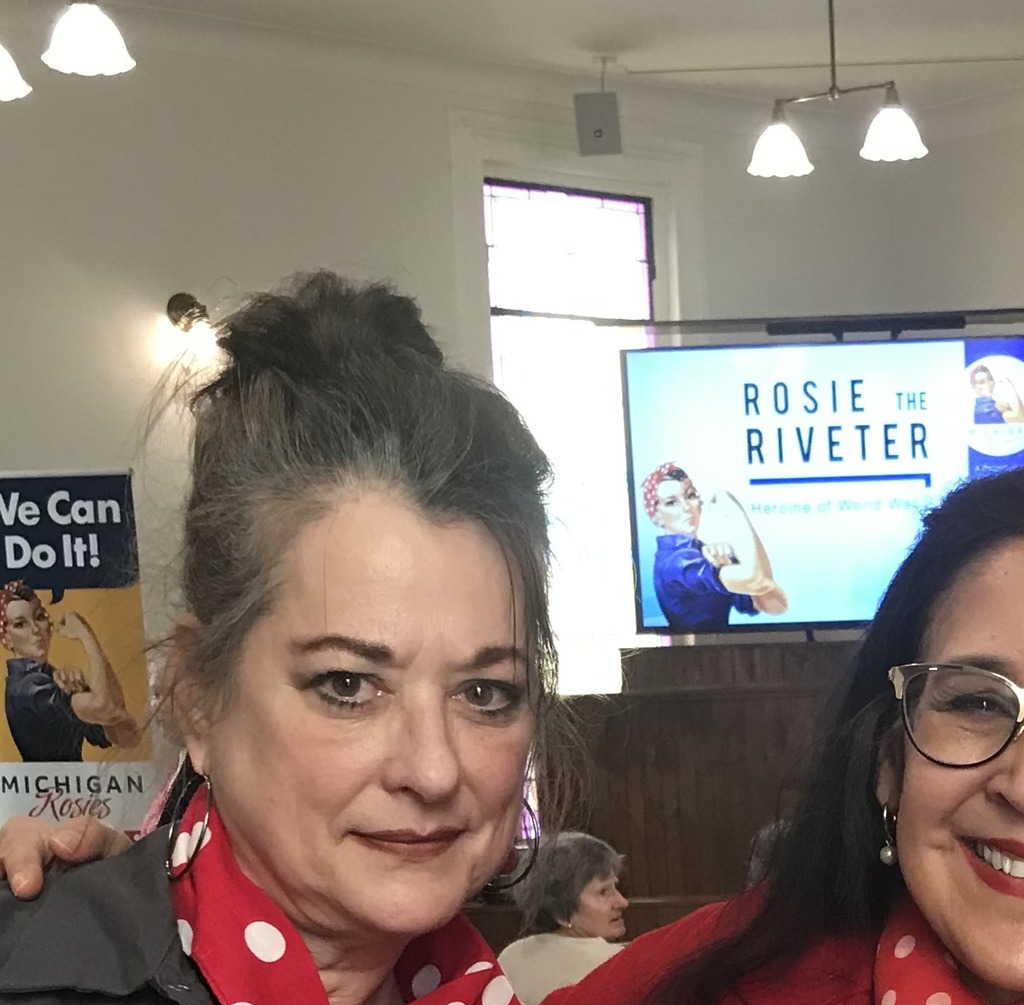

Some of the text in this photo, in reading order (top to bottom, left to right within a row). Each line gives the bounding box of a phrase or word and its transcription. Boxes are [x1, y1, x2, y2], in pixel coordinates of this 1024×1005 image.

[743, 379, 928, 416] ROSIE THE
[746, 422, 929, 465] RIVETER
[47, 490, 122, 525] Can
[751, 502, 811, 514] Heroine
[817, 500, 832, 514] of
[837, 499, 882, 512] World
[4, 533, 101, 569] Do It!
[1, 775, 144, 794] MICHIGAN
[28, 786, 112, 822] Rosies
